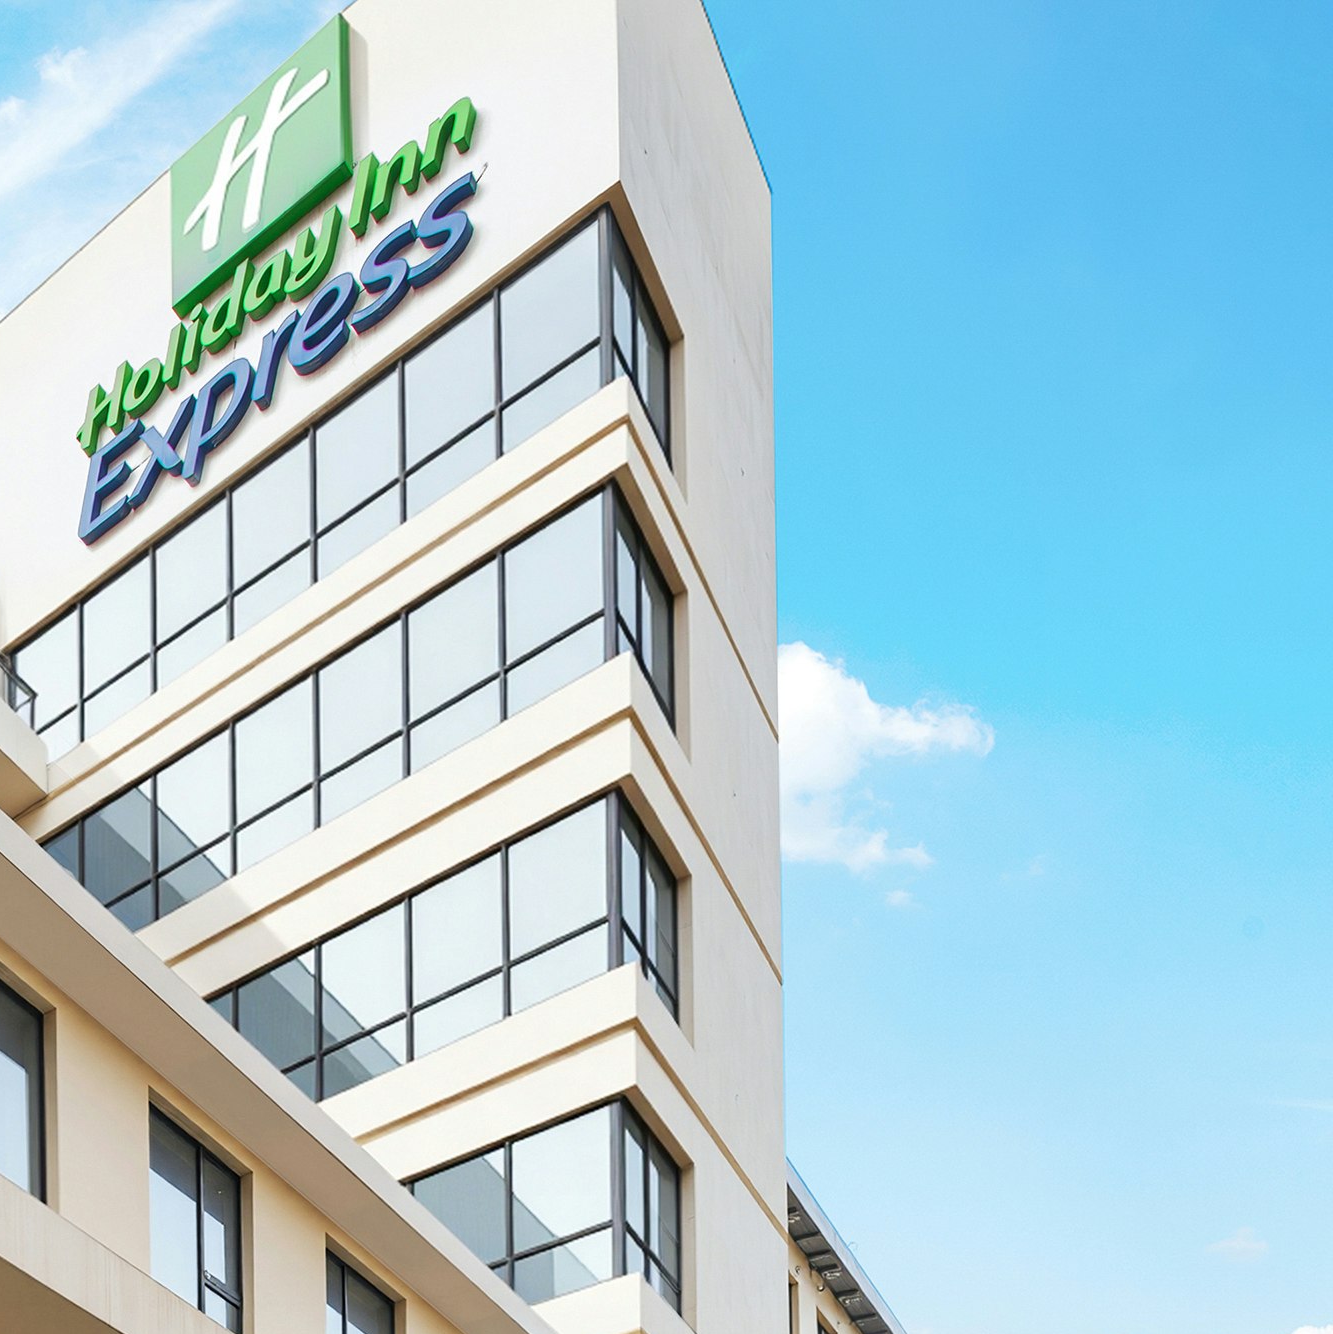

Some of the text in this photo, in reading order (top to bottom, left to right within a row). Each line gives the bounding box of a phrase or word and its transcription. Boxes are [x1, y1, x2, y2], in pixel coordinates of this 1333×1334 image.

[77, 97, 477, 456] Holiday Inn
[78, 172, 477, 545] Express
